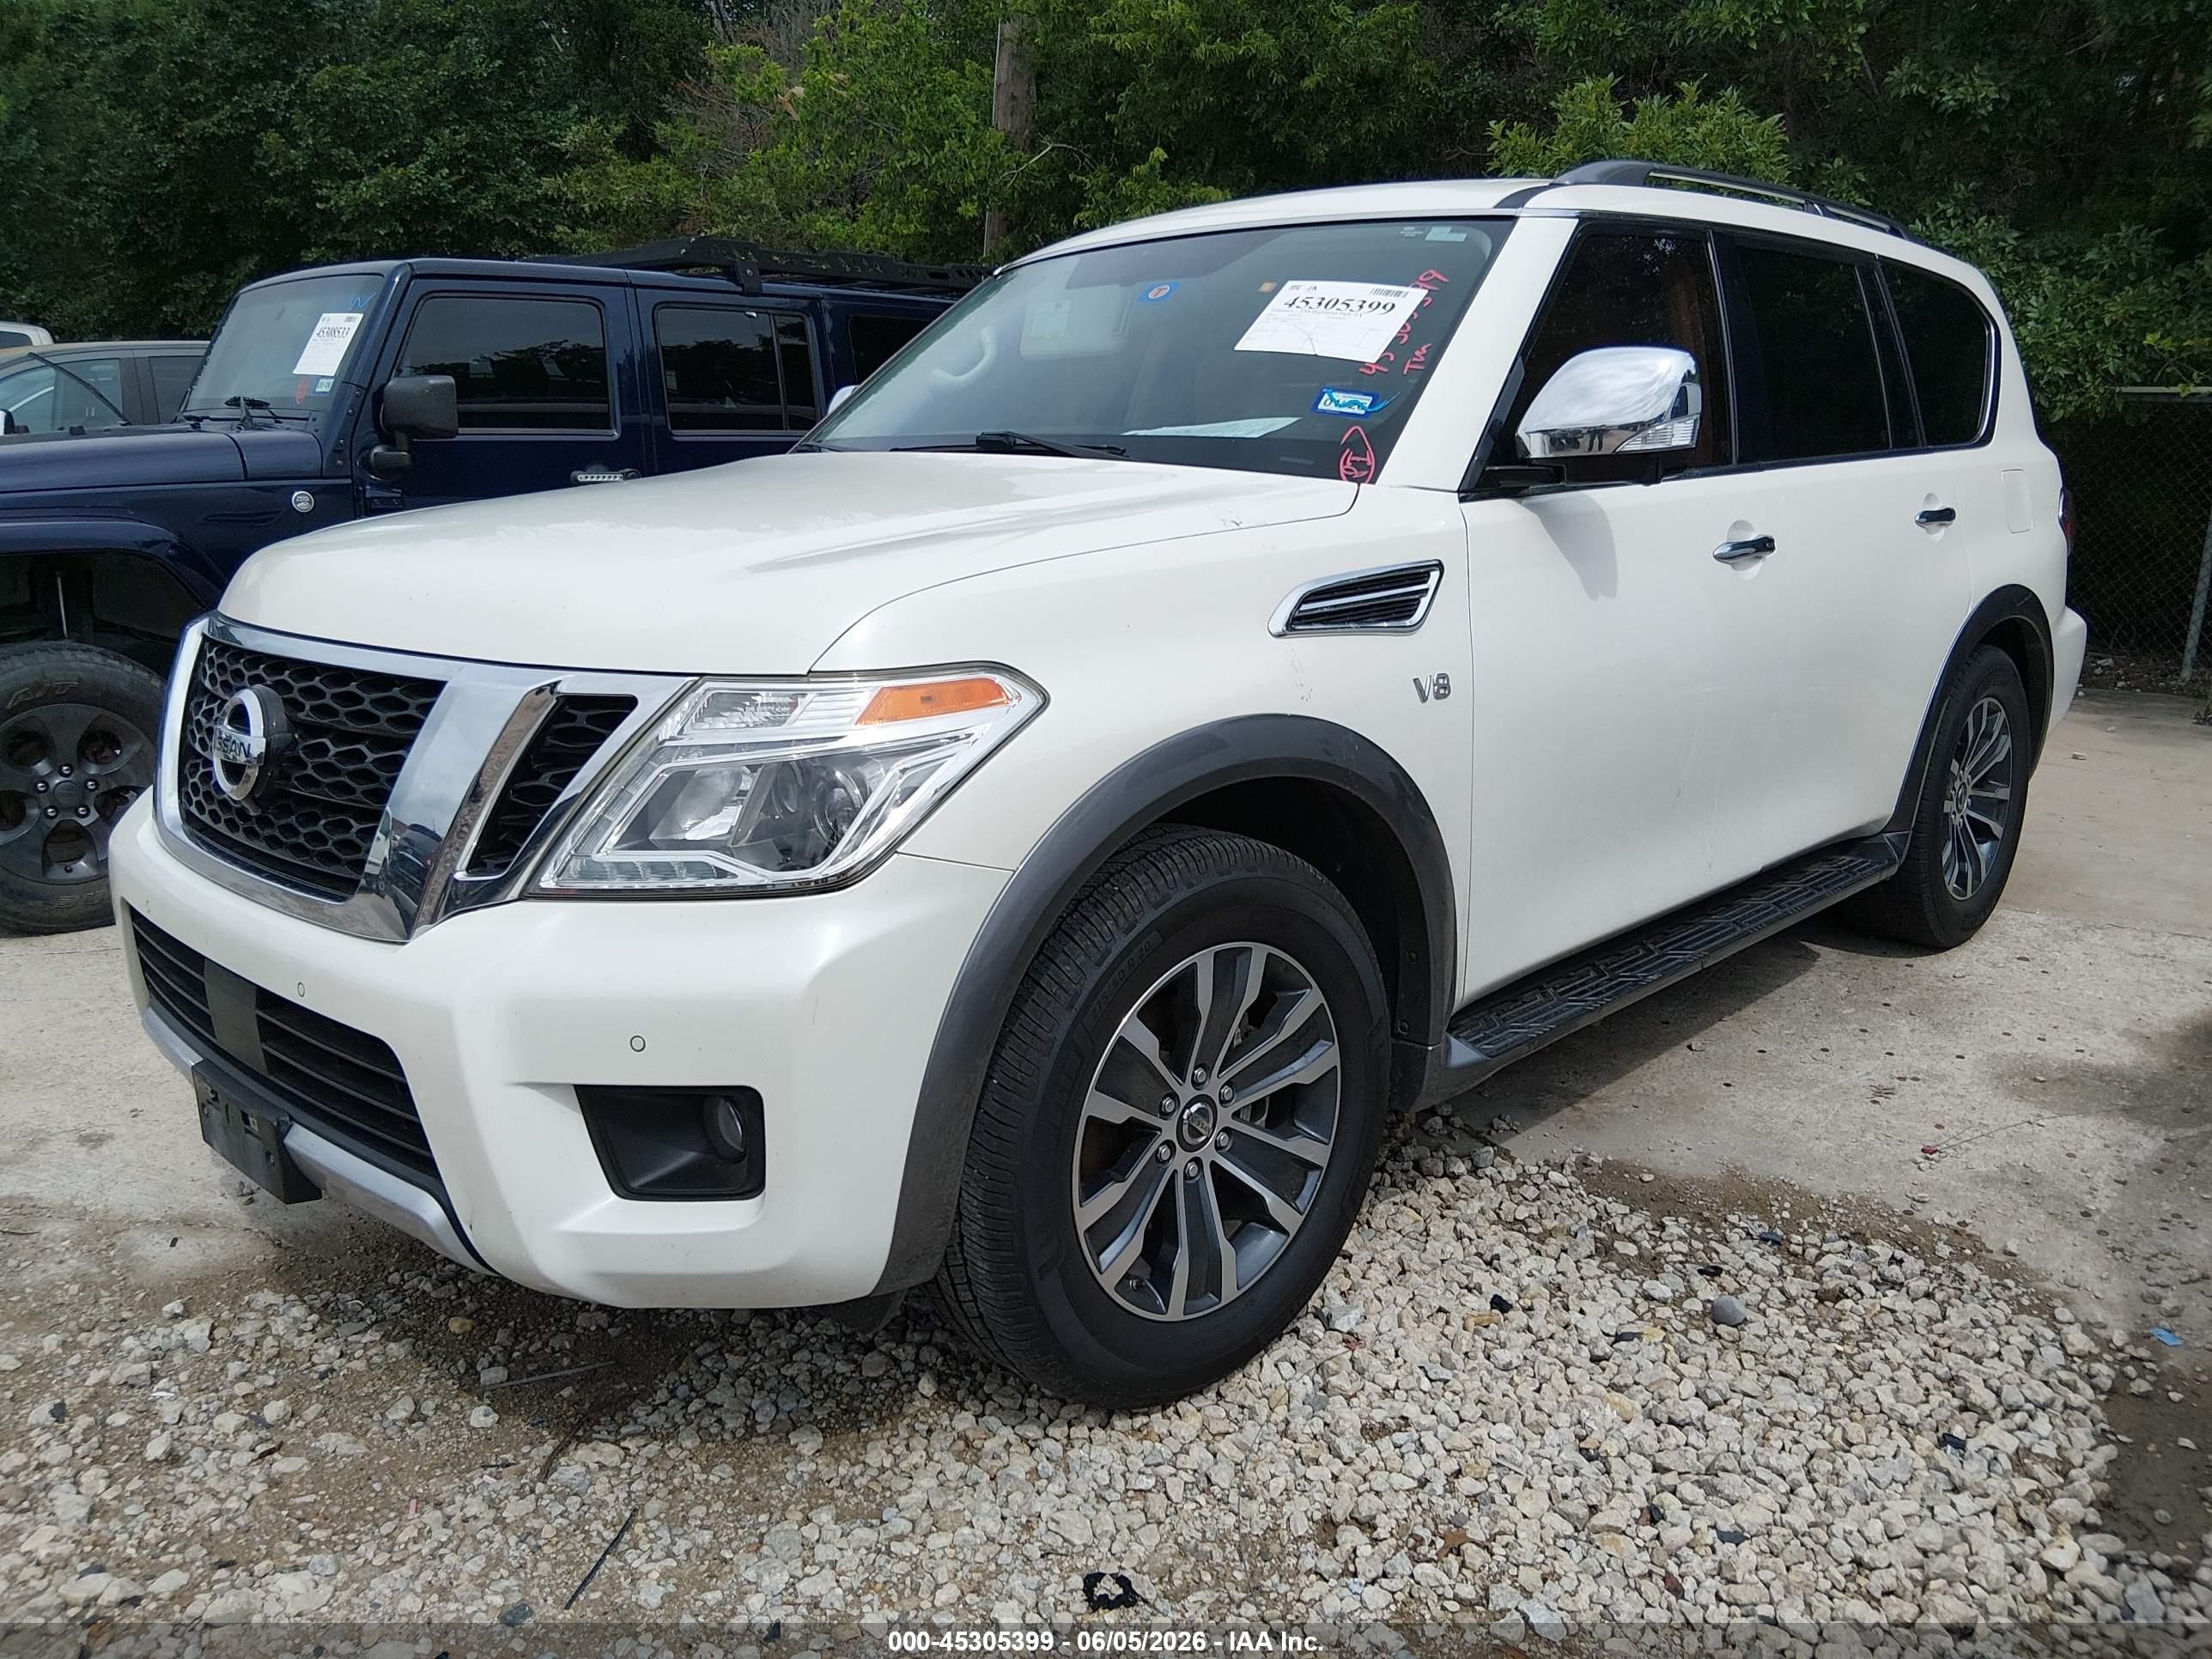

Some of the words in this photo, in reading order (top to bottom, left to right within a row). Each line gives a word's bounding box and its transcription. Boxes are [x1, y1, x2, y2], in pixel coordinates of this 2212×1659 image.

[1284, 295, 1396, 315] 45305399
[1413, 672, 1451, 703] V8
[216, 728, 252, 758] SSAN
